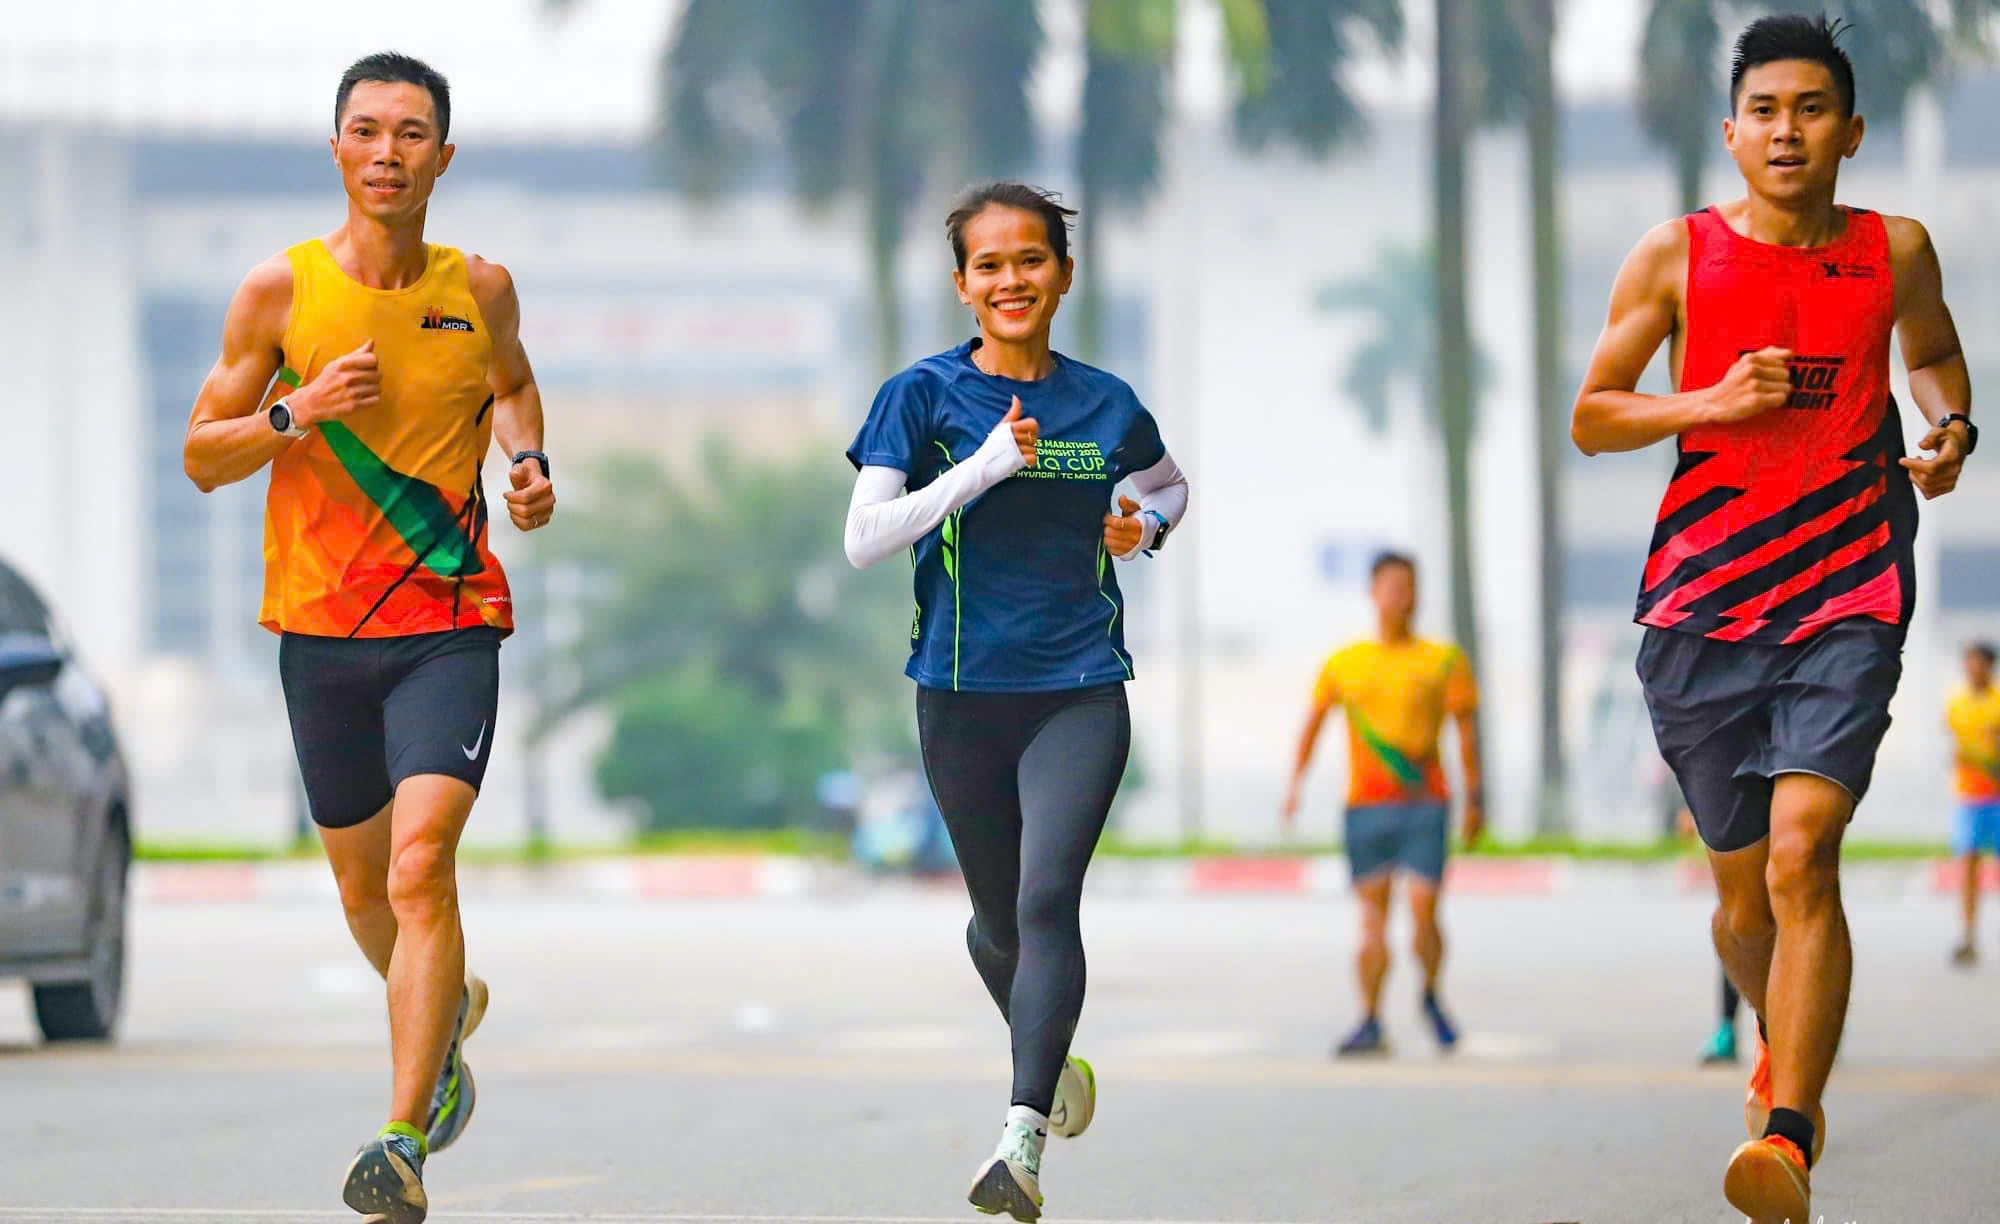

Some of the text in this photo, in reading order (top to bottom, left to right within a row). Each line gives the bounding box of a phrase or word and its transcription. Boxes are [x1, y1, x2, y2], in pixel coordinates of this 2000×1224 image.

[442, 321, 468, 331] MDR
[1044, 440, 1098, 449] MARATHON
[1079, 448, 1102, 457] 2023
[1066, 457, 1105, 471] CUP
[1061, 472, 1073, 480] TC
